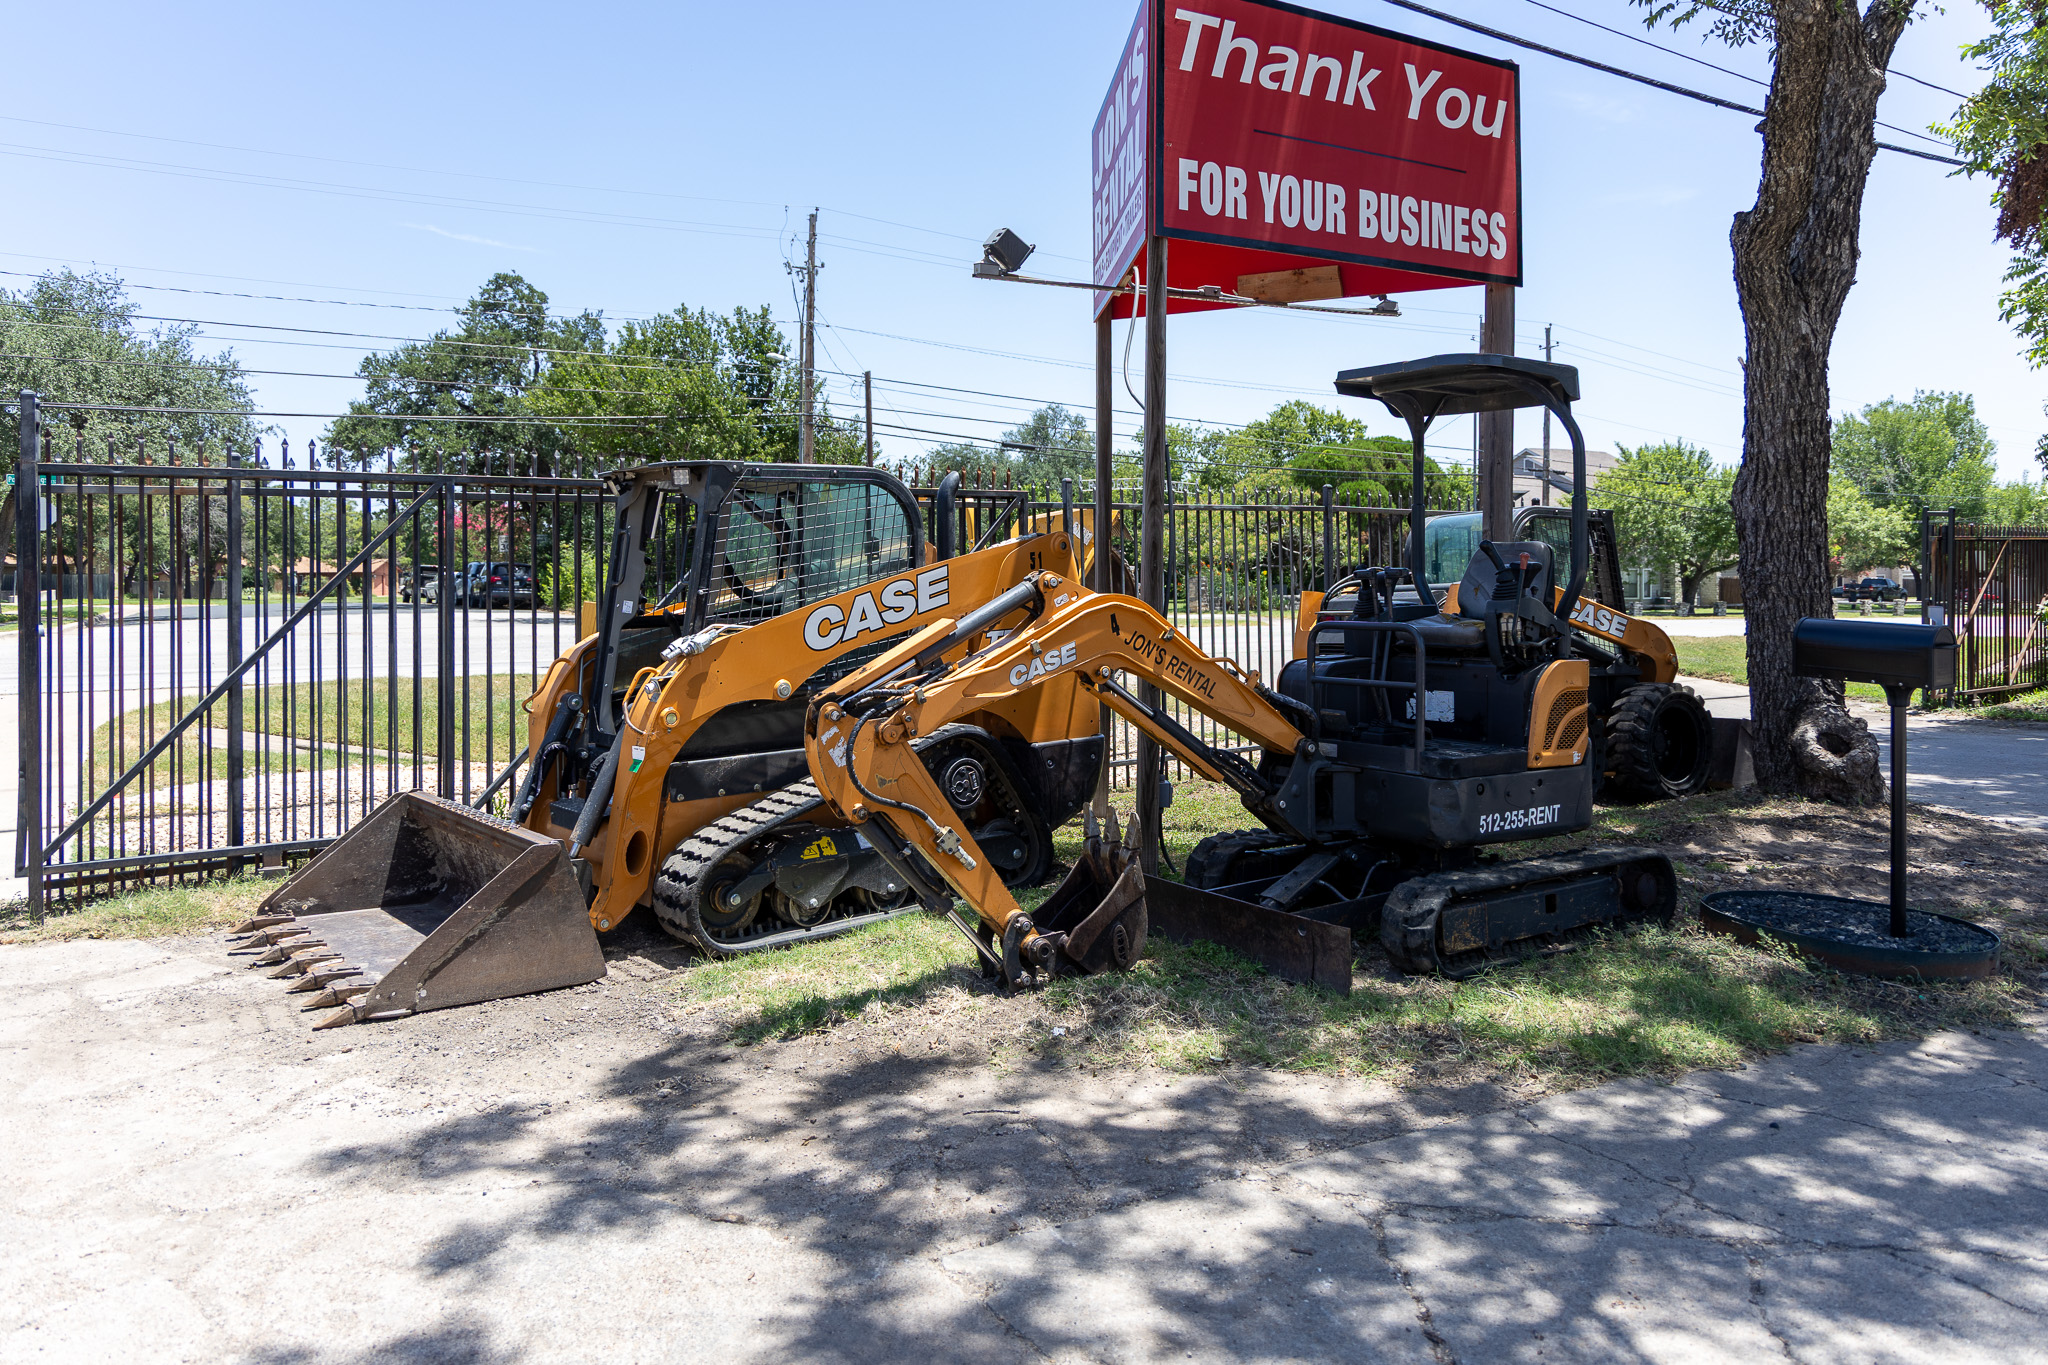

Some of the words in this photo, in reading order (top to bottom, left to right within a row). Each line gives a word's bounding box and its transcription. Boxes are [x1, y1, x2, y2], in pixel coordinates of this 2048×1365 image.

[1095, 26, 1144, 192] JON'S
[1175, 8, 1382, 111] Thank
[1404, 63, 1507, 138] You
[1095, 109, 1143, 260] RENTAL
[1179, 158, 1247, 220] FOR
[1258, 171, 1346, 235] YOUR
[1359, 189, 1507, 260] BUSINESS
[803, 564, 949, 651] CASE
[1110, 613, 1120, 636] 4
[1009, 640, 1077, 687] CASE
[1124, 630, 1167, 665] JON'S
[1165, 655, 1217, 699] RENTAL
[1479, 803, 1561, 834] 512-255-RENT
